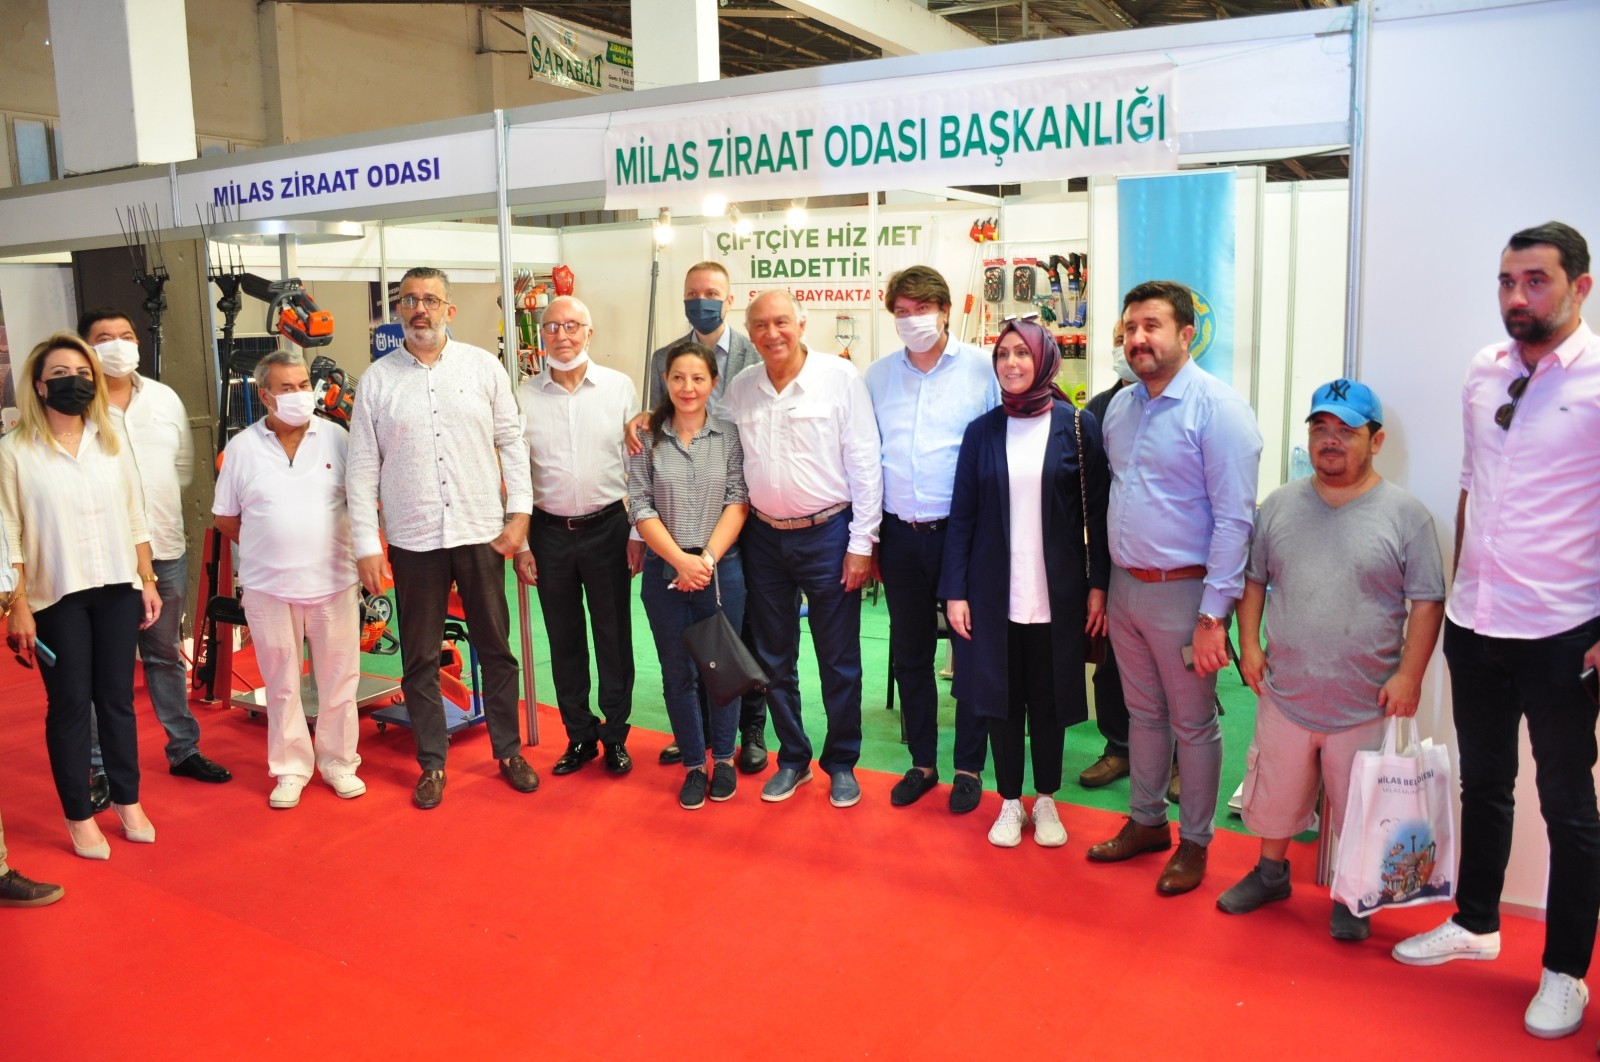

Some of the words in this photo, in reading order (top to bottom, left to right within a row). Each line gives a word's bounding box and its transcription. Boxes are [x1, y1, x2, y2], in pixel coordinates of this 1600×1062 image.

[532, 35, 604, 87] SARABAT
[615, 136, 699, 186] MİLAS
[707, 127, 814, 179] ZİRAAT
[824, 117, 926, 169] ODASI
[939, 85, 1166, 167] BAŞKANLIĞI
[213, 179, 274, 208] MİLAS
[280, 168, 359, 199] ZİRAAT
[367, 157, 440, 189] ODASI
[716, 224, 820, 256] ÇİFTÇİYE
[827, 221, 922, 247] HİZMET
[796, 288, 884, 302] BAYRAKTAR
[1378, 775, 1402, 785] MİLAS
